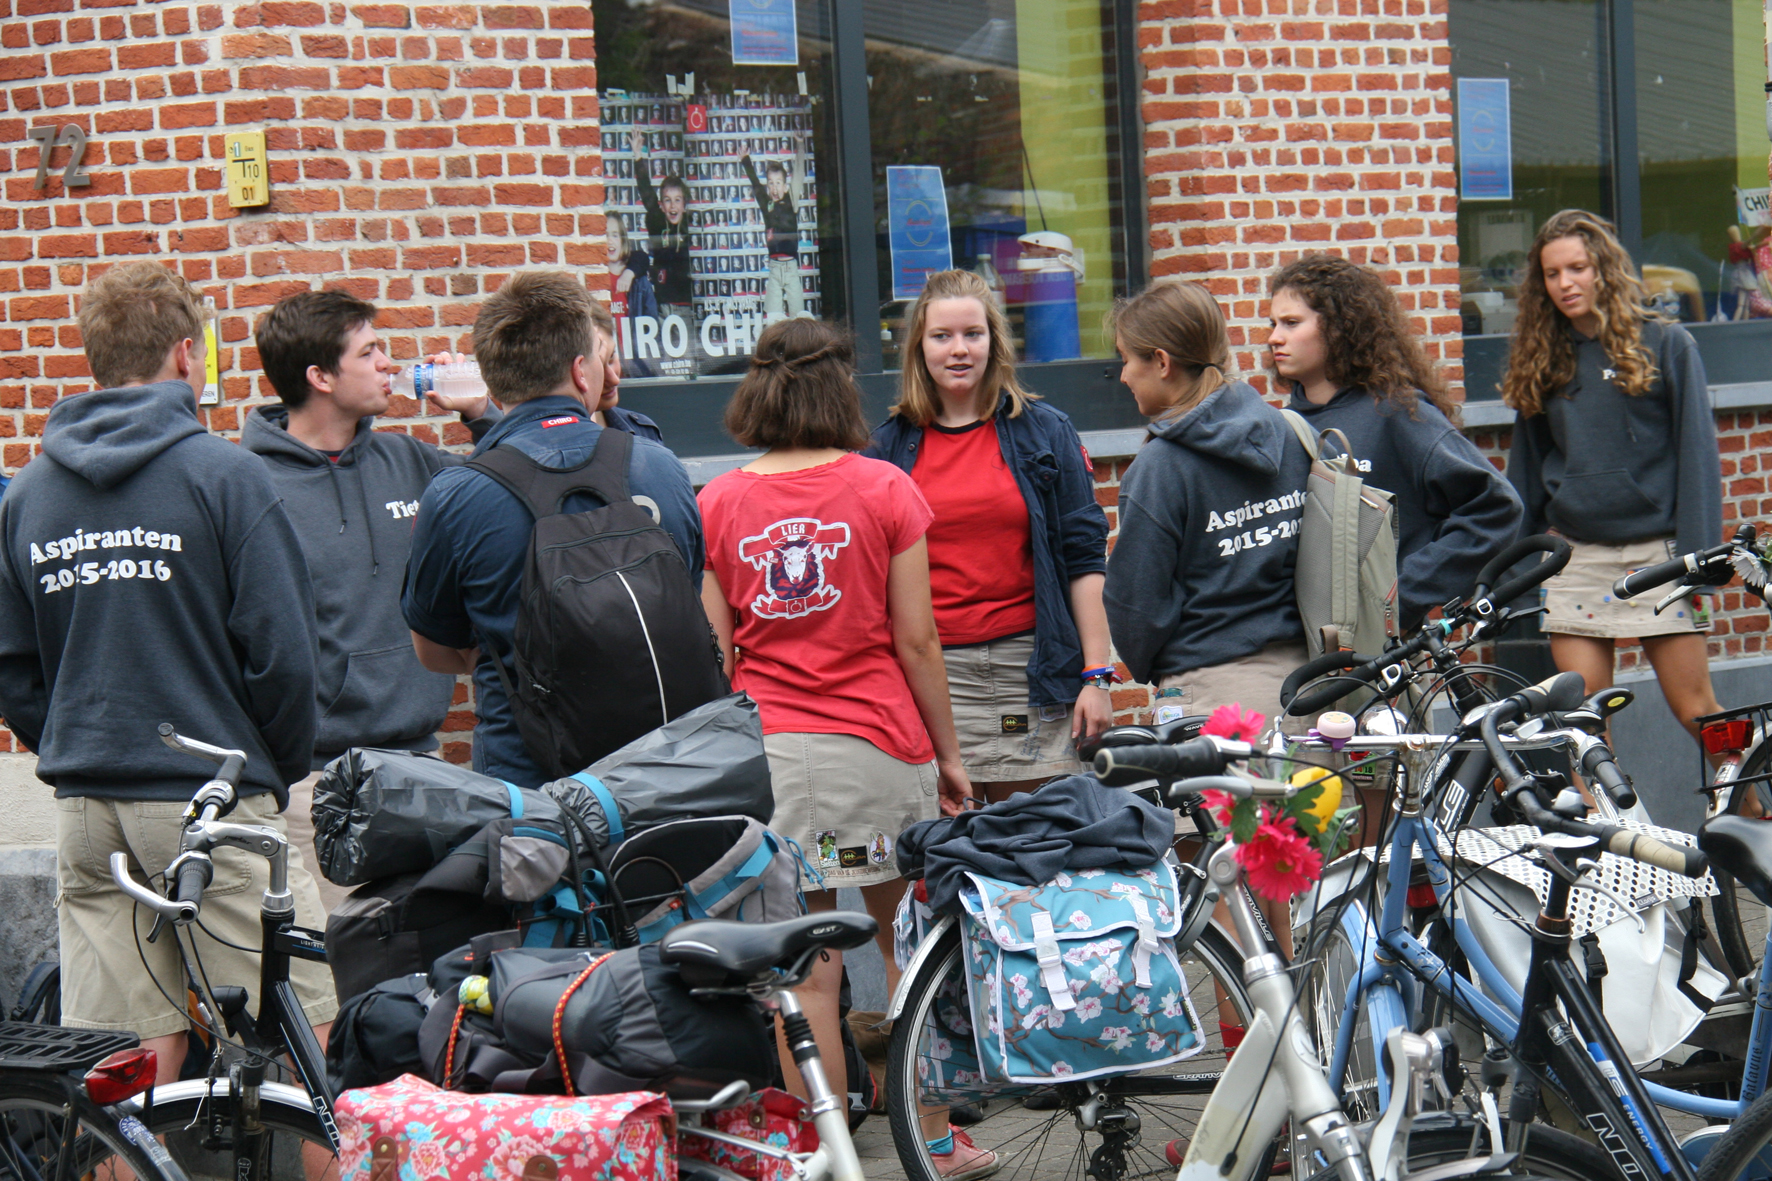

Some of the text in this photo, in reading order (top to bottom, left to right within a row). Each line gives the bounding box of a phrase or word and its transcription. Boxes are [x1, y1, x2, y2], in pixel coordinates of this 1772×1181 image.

[28, 123, 91, 190] 72
[548, 416, 572, 425] CHIRO
[30, 526, 183, 566] Aspiranten
[781, 523, 806, 536] LIER
[40, 559, 172, 594] 2015-2016
[1622, 1103, 1653, 1150] ENERGY
